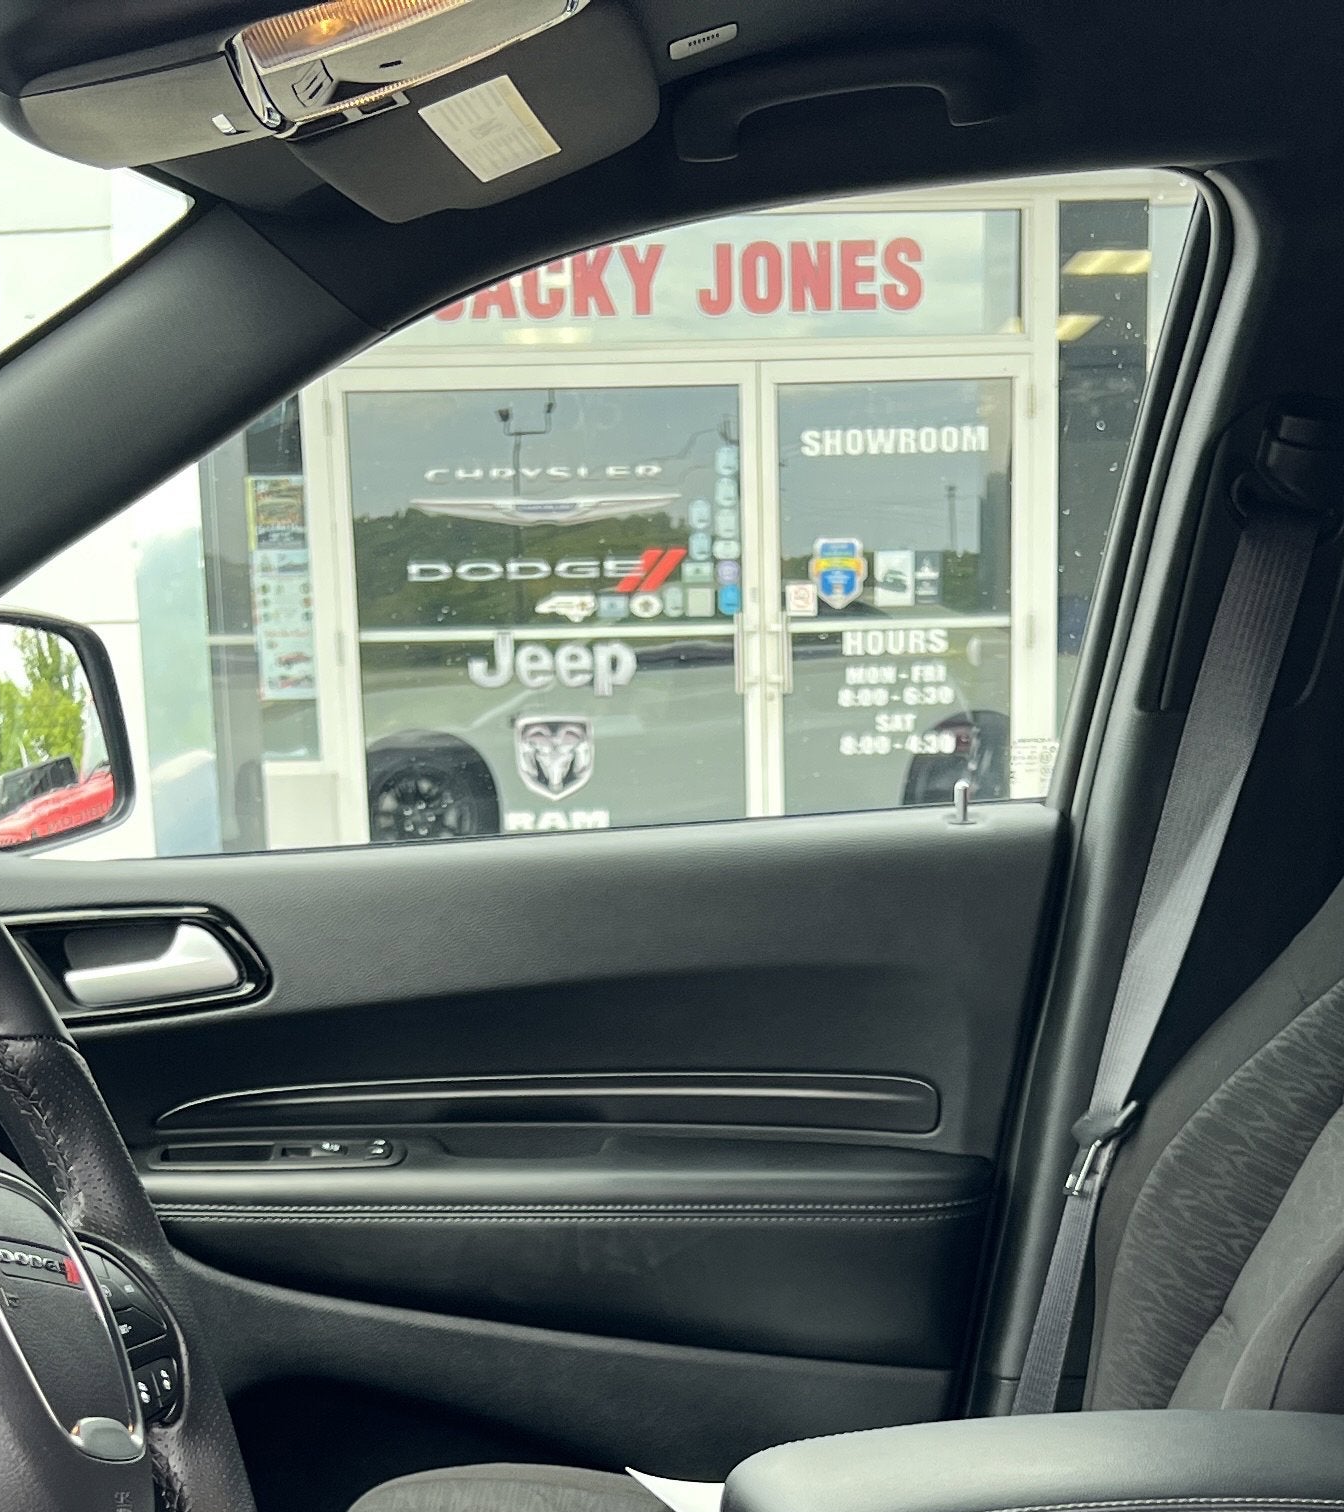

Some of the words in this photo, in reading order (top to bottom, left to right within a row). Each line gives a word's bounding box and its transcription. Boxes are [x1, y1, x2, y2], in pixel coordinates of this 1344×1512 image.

[698, 236, 923, 316] JONES
[800, 424, 990, 457] SHOWROOM
[423, 464, 663, 483] CHRYSLER
[406, 558, 646, 583] DODGE
[841, 628, 949, 656] HOURS
[467, 632, 638, 697] Jeep
[874, 712, 917, 733] SAT
[506, 809, 610, 831] RAM
